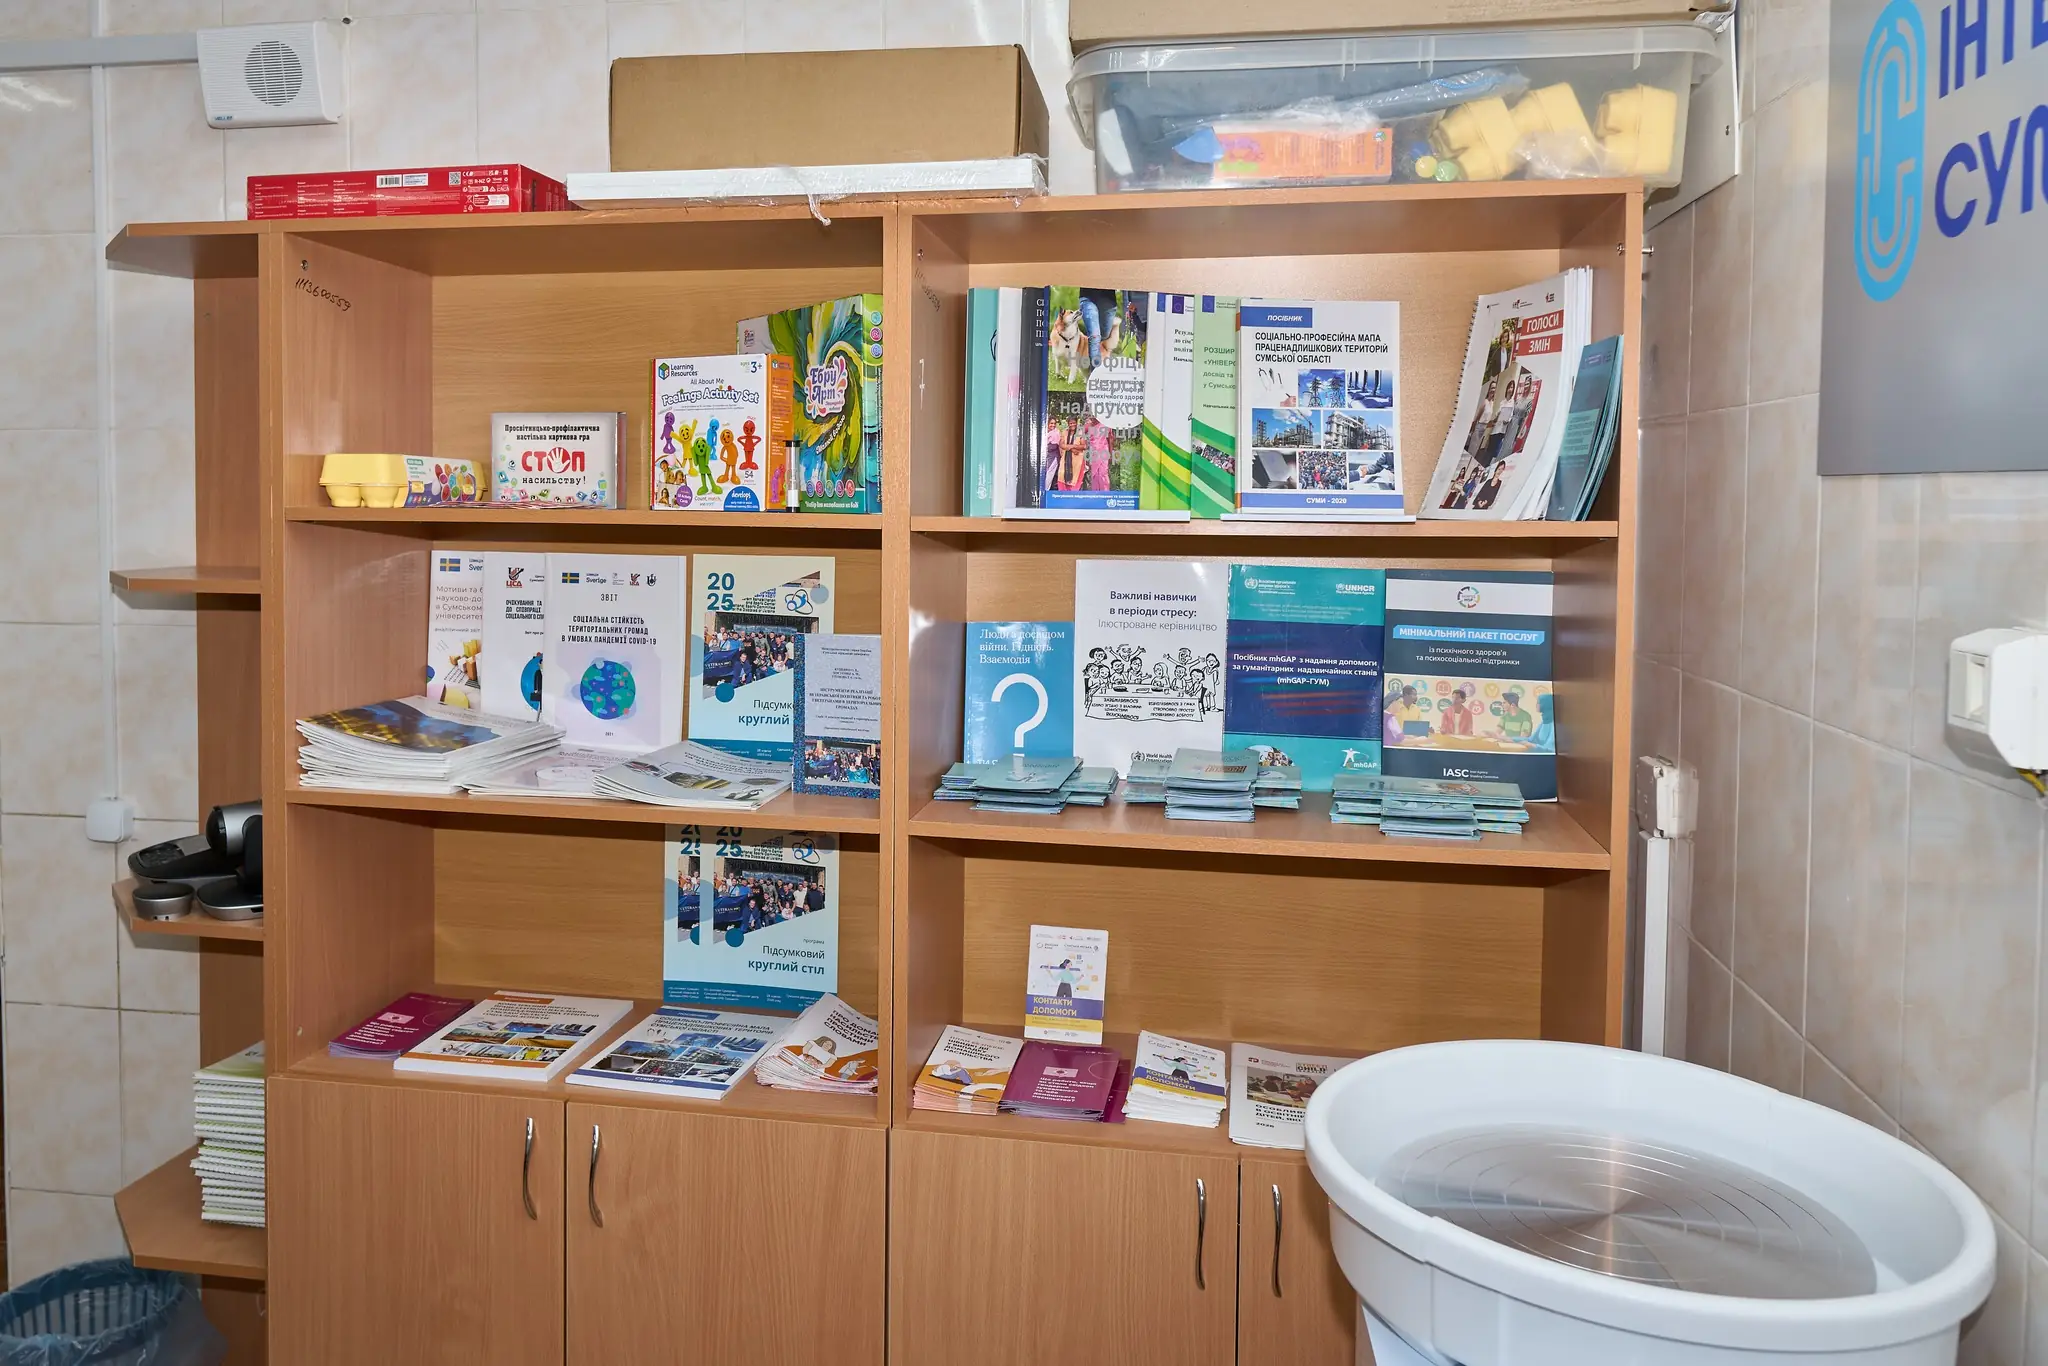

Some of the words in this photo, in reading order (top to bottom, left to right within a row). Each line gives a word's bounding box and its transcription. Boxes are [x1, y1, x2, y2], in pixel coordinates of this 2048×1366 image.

[1267, 314, 1303, 322] ПОСІБНИК
[1526, 313, 1559, 333] ГОЛОСИ
[1255, 332, 1356, 342] СОЦІАЛЬНО-ПРОФЕСІЙНА
[1358, 334, 1381, 342] МАПА
[1255, 343, 1342, 354] ПРАЦЕНАДЛИШКОВИХ
[1345, 344, 1388, 353] ТЕРИТОРІЙ
[1528, 338, 1551, 353] ЗМІН
[1255, 353, 1295, 362] СУМСЬКОЇ
[1297, 355, 1331, 364] ОБЛАСТІ
[662, 389, 701, 406] Feelings
[703, 385, 741, 402] Activity
[742, 389, 759, 404] Set
[521, 447, 585, 474] СТОП
[522, 476, 586, 485] насильству!
[707, 572, 735, 590] 20
[707, 593, 734, 611] 25
[1110, 590, 1152, 603] Важливі
[1154, 592, 1197, 603] навички
[1118, 606, 1158, 618] періоди
[1160, 608, 1197, 619] стресу:
[611, 616, 644, 624] СТІЙКІСТЬ
[1098, 619, 1156, 631] Ілюстроване
[1159, 619, 1218, 632] керівництво
[568, 625, 622, 634] ТЕРИТОРІАЛЬНИХ
[624, 627, 649, 635] ГРОМАД
[980, 629, 1008, 640] Люди
[1020, 630, 1065, 640] досвідом
[1399, 627, 1467, 639] МІНІМАЛЬНИЙ
[1468, 631, 1498, 640] ПАКЕТ
[1499, 633, 1538, 642] ПОСЛУГ
[568, 635, 593, 643] УМОВАХ
[594, 635, 627, 644] ПАНДЕМІЇ
[629, 637, 657, 645] COVID-19
[980, 642, 1009, 651] війни.
[1012, 642, 1054, 652] Гідність.
[1436, 647, 1474, 656] психічного
[980, 654, 1030, 665] Взаємодія
[1234, 653, 1267, 662] Посібник
[1269, 655, 1297, 663] mhGAP
[1425, 655, 1482, 664] психосоціальної
[1483, 658, 1520, 666] підтримки
[1242, 665, 1294, 673] гуманітарних
[1297, 667, 1353, 675] надзвичайних
[739, 715, 790, 726] круглий
[1443, 768, 1469, 778] IASC
[716, 839, 742, 857] 25
[763, 946, 825, 959] Підсумковий
[748, 960, 798, 973] круглий
[801, 965, 825, 975] стіл
[1033, 996, 1073, 1006] КОНТАКТИ
[833, 1010, 849, 1022] ПРО
[1033, 1006, 1077, 1016] ДОПОМОГИ
[824, 1022, 866, 1046] СЛОВАМИ
[827, 1018, 874, 1043] ПРОСТИМИ
[1146, 1068, 1190, 1084] КОНТАКТИ
[1146, 1076, 1196, 1090] ДОПОМОГИ
